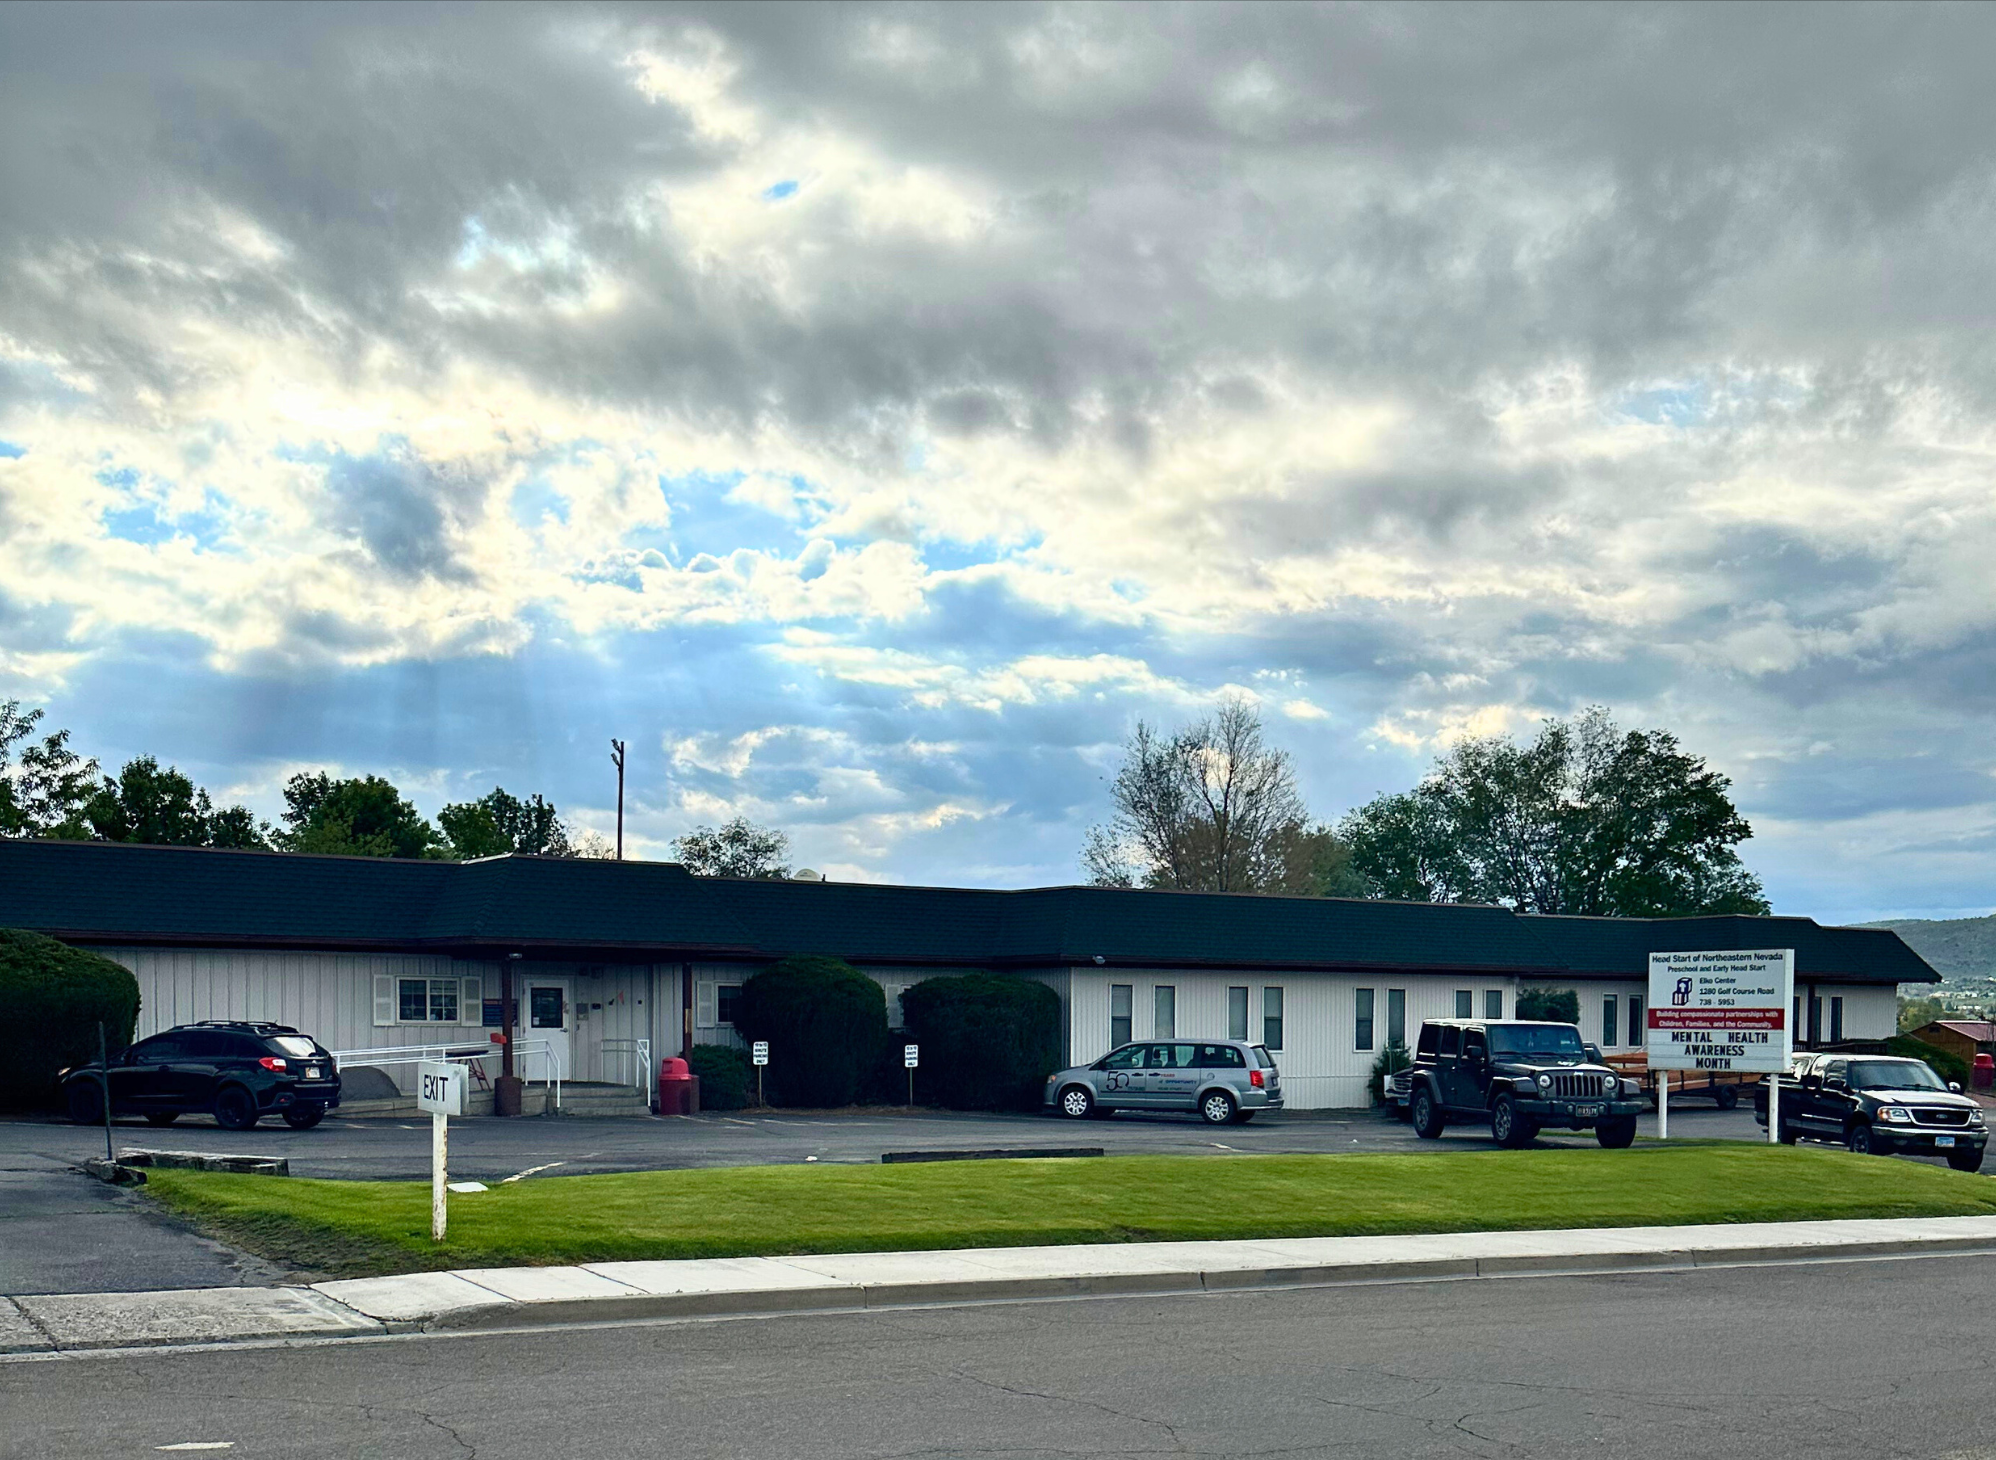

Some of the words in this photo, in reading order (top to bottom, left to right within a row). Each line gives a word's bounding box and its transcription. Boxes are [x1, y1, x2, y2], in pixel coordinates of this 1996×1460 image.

[1652, 955, 1671, 963] Head
[1673, 954, 1691, 963] Start
[1693, 953, 1701, 962] of
[1702, 952, 1752, 961] Northeastern
[1754, 952, 1783, 961] Nevada
[1667, 965, 1698, 973] Preschool
[1699, 964, 1711, 972] and
[1713, 964, 1729, 973] Early
[1730, 964, 1748, 972] Head
[1656, 1010, 1680, 1018] Building
[1726, 1010, 1764, 1018] partnerships
[1765, 1010, 1779, 1018] with
[1659, 1020, 1685, 1028] Children,
[1686, 1020, 1712, 1028] Families,
[1713, 1020, 1725, 1028] and
[1726, 1020, 1736, 1028] the
[1671, 1031, 1713, 1043] MENTAL
[1728, 1032, 1769, 1044] HEALTH
[1684, 1045, 1745, 1057] AWARENESS
[1696, 1058, 1731, 1069] MONTH
[424, 1074, 448, 1102] EXIT
